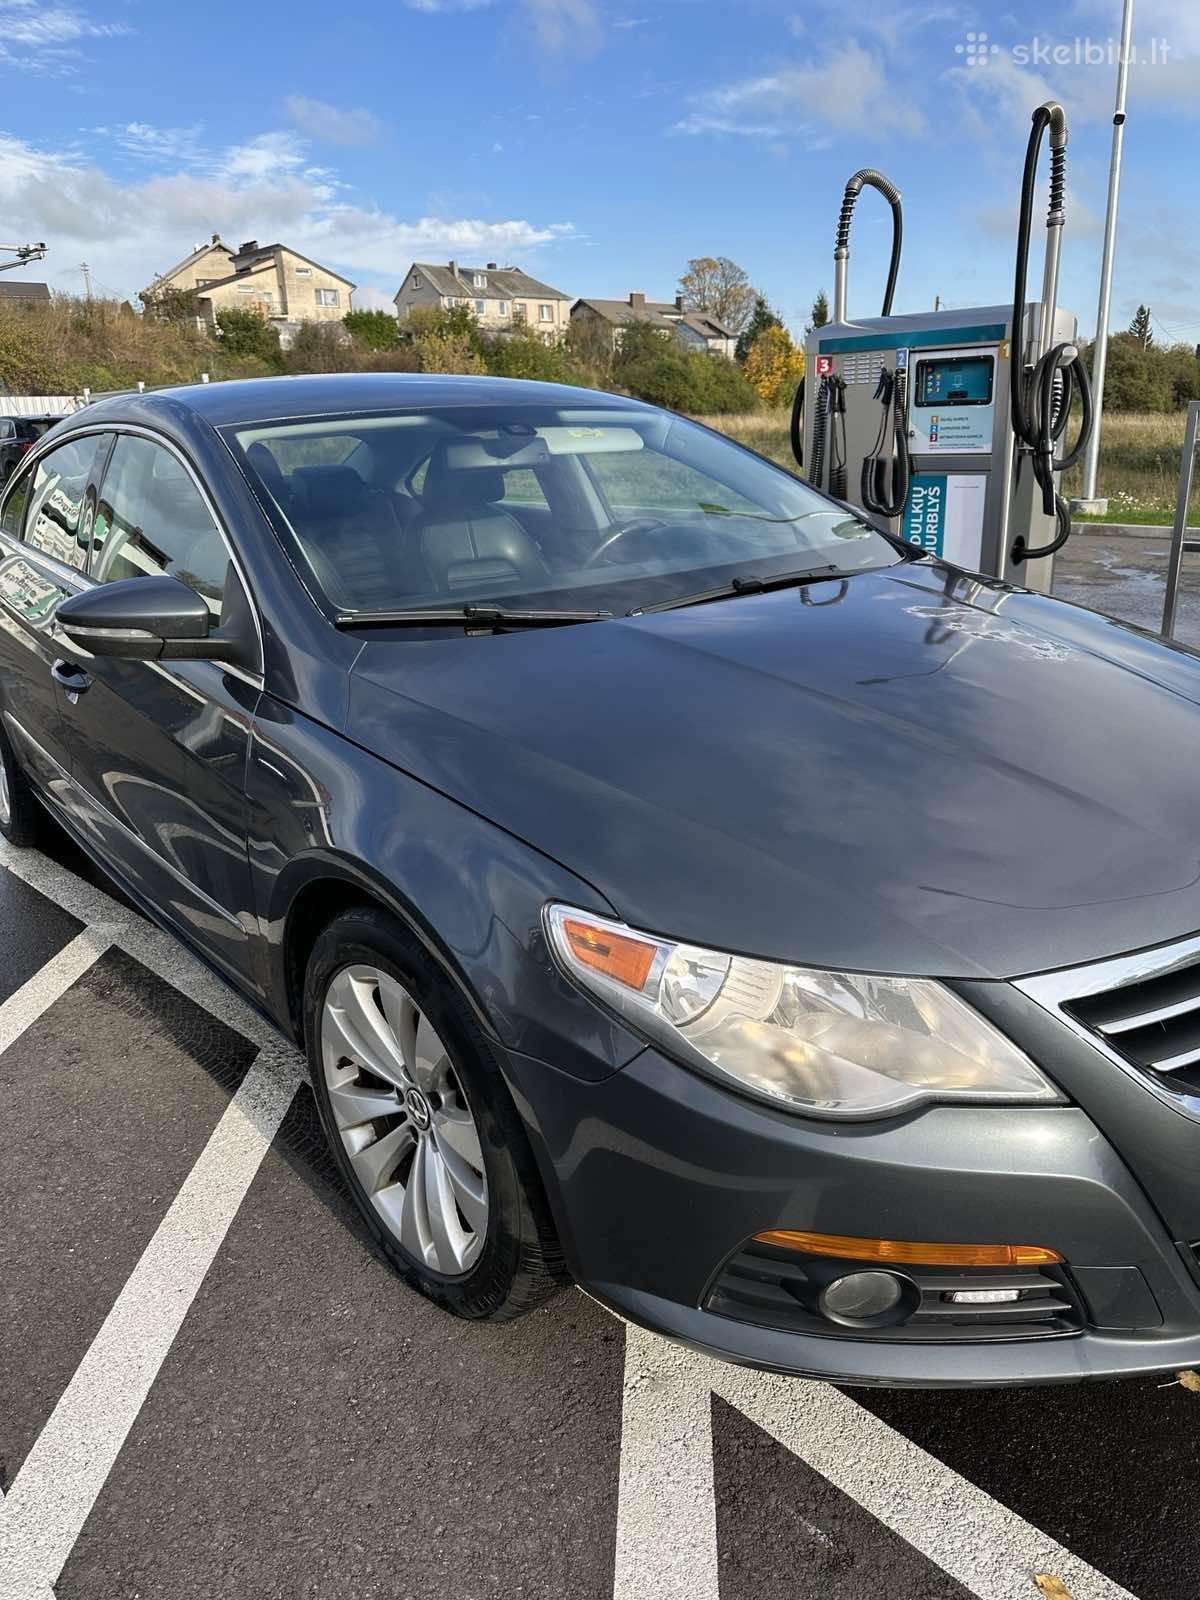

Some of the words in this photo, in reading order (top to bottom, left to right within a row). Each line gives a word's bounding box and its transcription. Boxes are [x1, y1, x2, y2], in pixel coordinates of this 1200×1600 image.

[1003, 343, 1010, 357] 1
[819, 359, 830, 372] 3
[898, 351, 905, 366] 2
[909, 486, 928, 545] DULKIŲ
